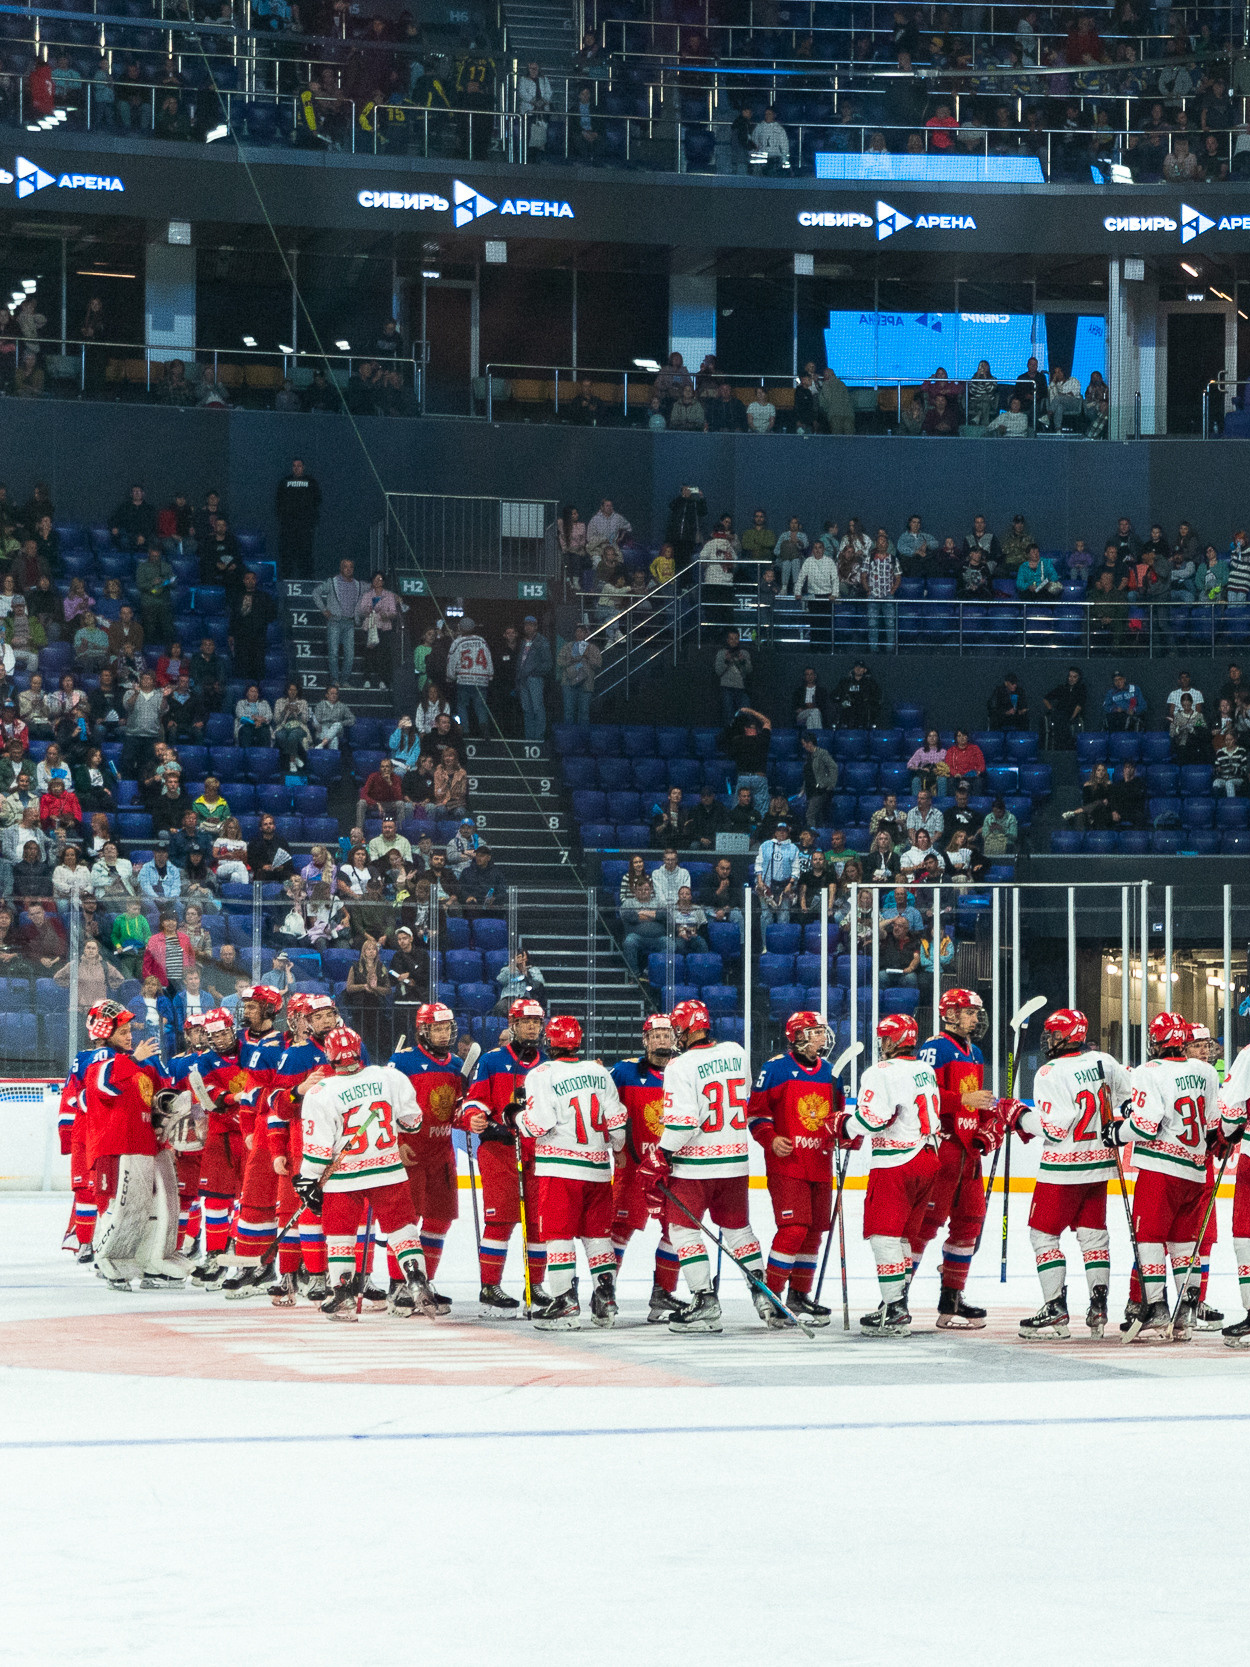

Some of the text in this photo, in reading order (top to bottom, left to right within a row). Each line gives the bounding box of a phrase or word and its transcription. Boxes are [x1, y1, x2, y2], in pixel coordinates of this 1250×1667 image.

[387, 106, 405, 121] 15
[58, 173, 125, 192] АРЕНА
[358, 190, 574, 218] СИБИРЬ АРЕНА
[799, 212, 977, 229] СИБИРЬ АРЕНА
[1104, 216, 1177, 231] СИБИРЬ
[287, 583, 302, 597] 15
[403, 580, 424, 593] H2
[523, 585, 544, 597] H3
[292, 613, 308, 625] 14
[296, 644, 311, 657] 13
[461, 650, 487, 671] 54
[302, 675, 317, 687] 12
[466, 745, 540, 758] 0 10
[469, 778, 550, 791] 9 9
[476, 815, 559, 829] 8 8
[559, 851, 569, 864] 7
[565, 1031, 575, 1039] 14
[341, 1051, 353, 1059] 53
[697, 1057, 742, 1080] BRYZGALOV
[1074, 1068, 1100, 1085] PAVLO
[338, 1082, 383, 1105] YELISEYEV
[701, 1078, 748, 1133] 35
[1038, 1099, 1052, 1114] 0
[569, 1093, 610, 1145] 14
[301, 1118, 315, 1136] 3
[342, 1101, 396, 1155] 53
[120, 1169, 130, 1207] CCM
